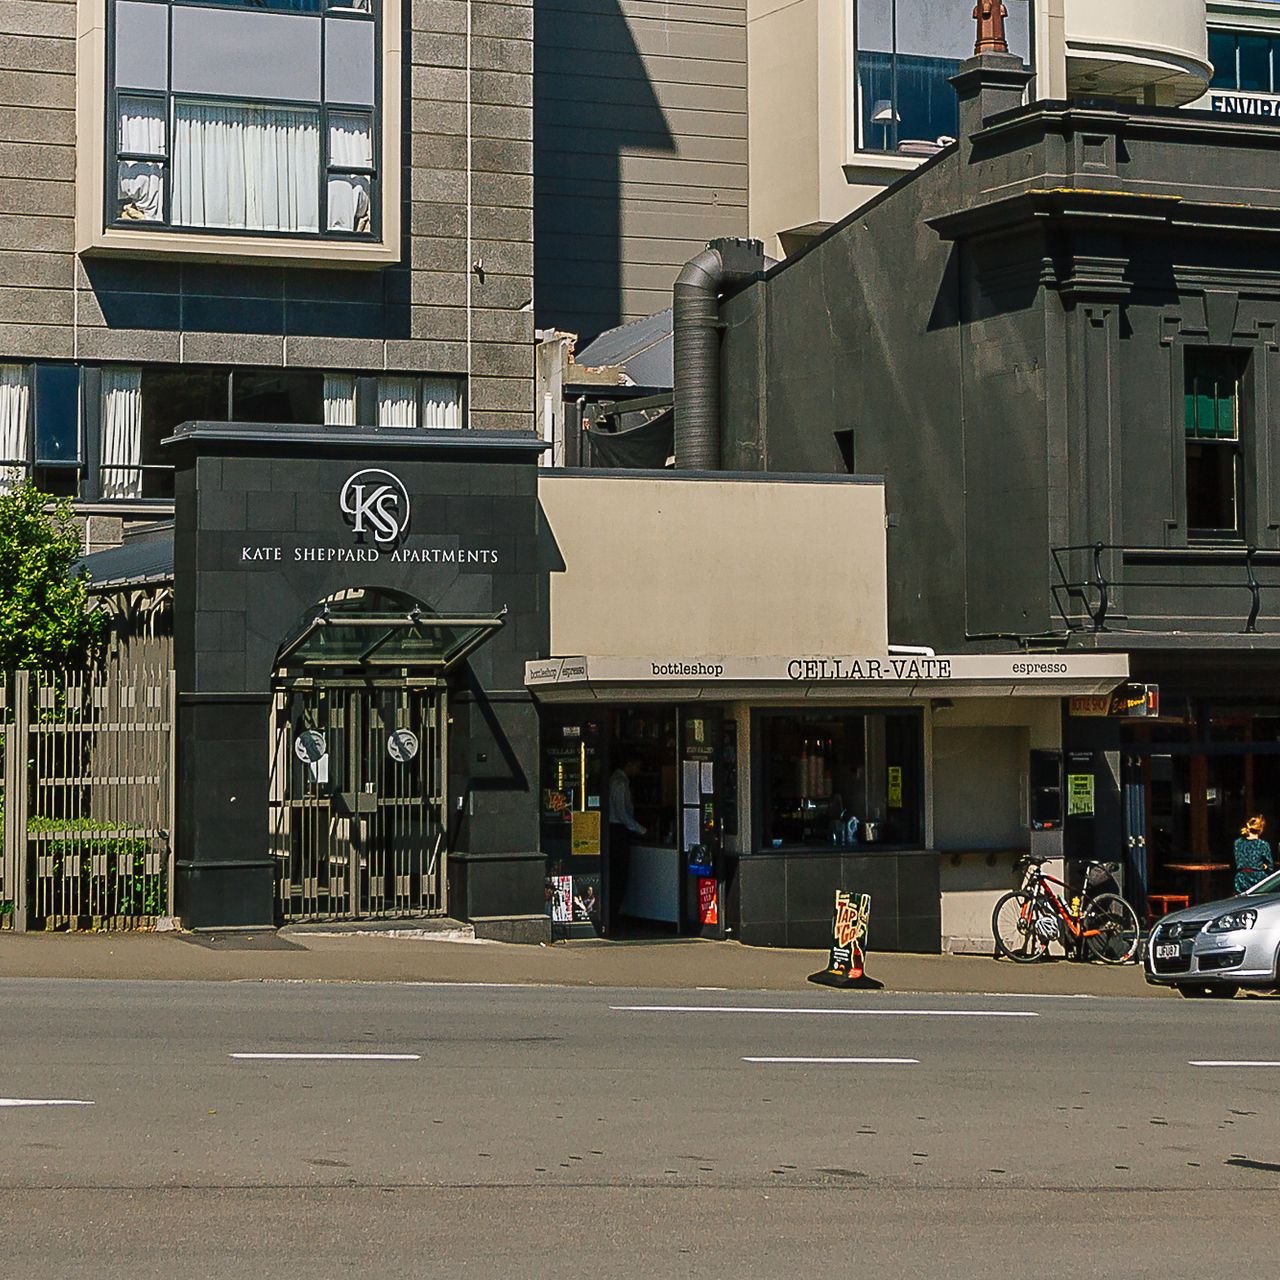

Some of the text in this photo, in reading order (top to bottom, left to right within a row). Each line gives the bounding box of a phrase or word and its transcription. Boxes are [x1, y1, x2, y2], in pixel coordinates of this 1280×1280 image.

[351, 484, 398, 542] KS
[242, 548, 499, 563] KATE SHEPPARD APARTMENTS
[652, 663, 723, 678] bottleshop
[788, 660, 951, 679] CELLAR-VATE
[1012, 662, 1068, 675] espresso
[838, 902, 856, 923] TAP
